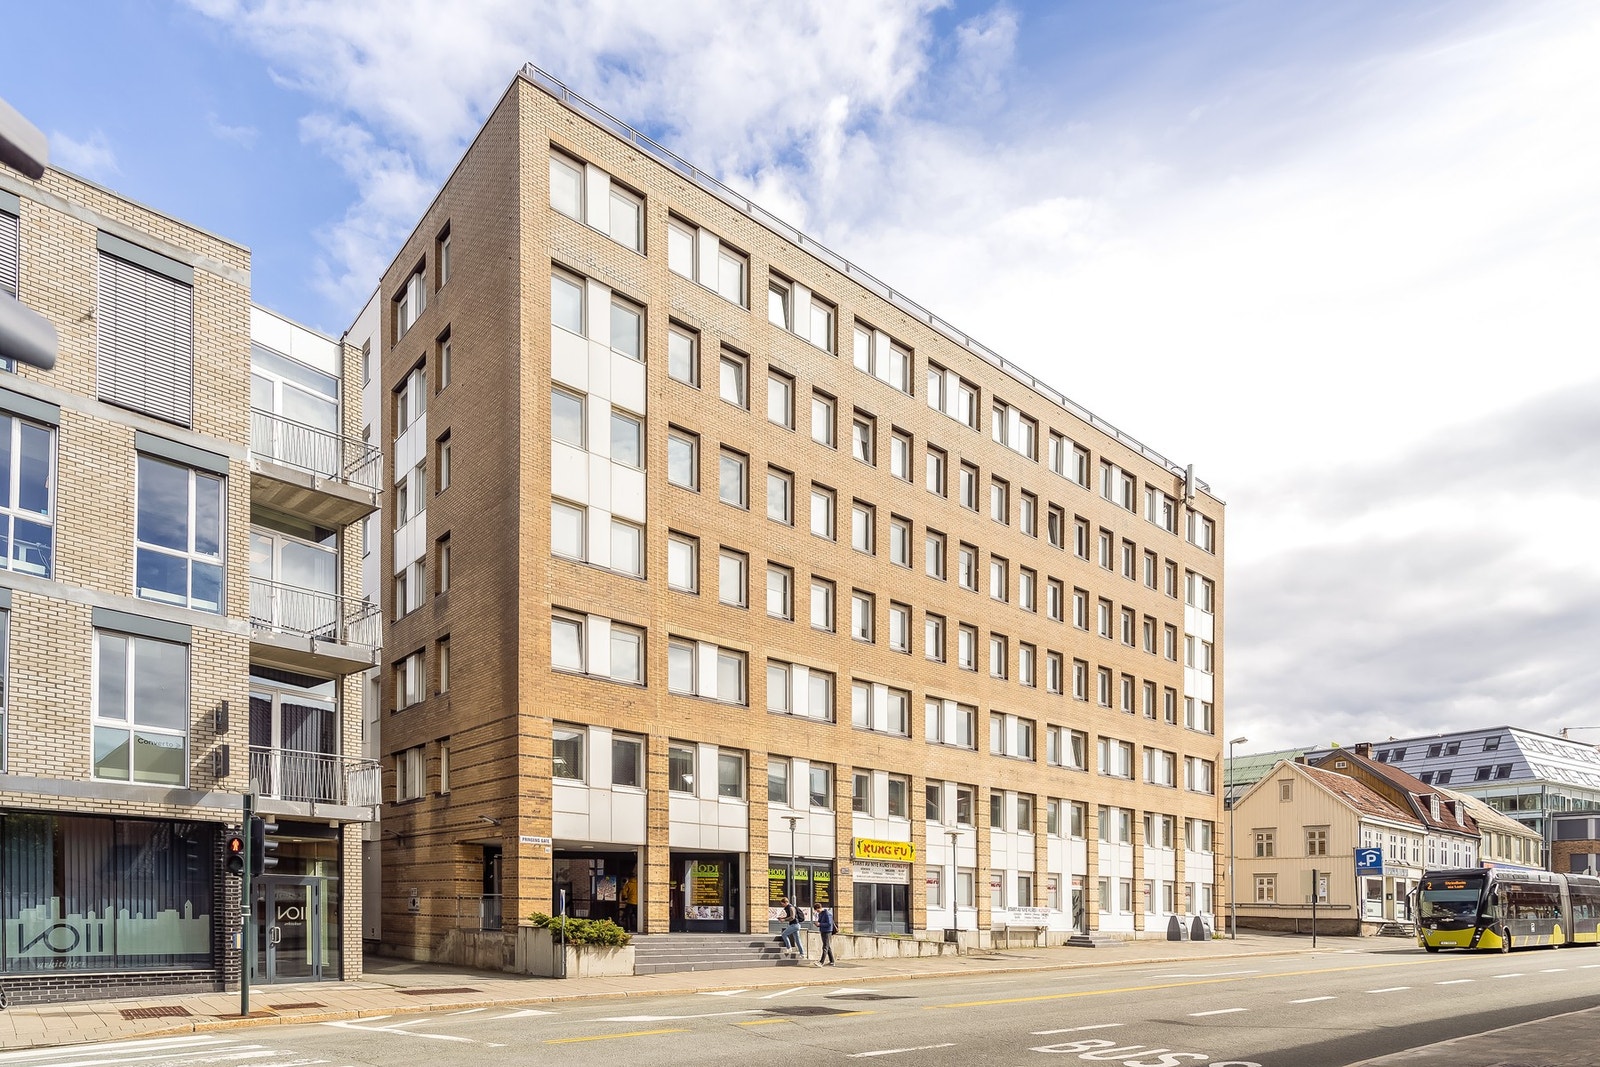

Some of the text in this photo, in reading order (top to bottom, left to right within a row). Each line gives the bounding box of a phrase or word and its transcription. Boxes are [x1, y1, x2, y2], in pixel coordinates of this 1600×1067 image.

[137, 737, 174, 748] Converto
[864, 844, 907, 856] KUNG FU
[1366, 854, 1376, 866] P
[692, 864, 719, 873] HODI
[1427, 882, 1432, 890] 2
